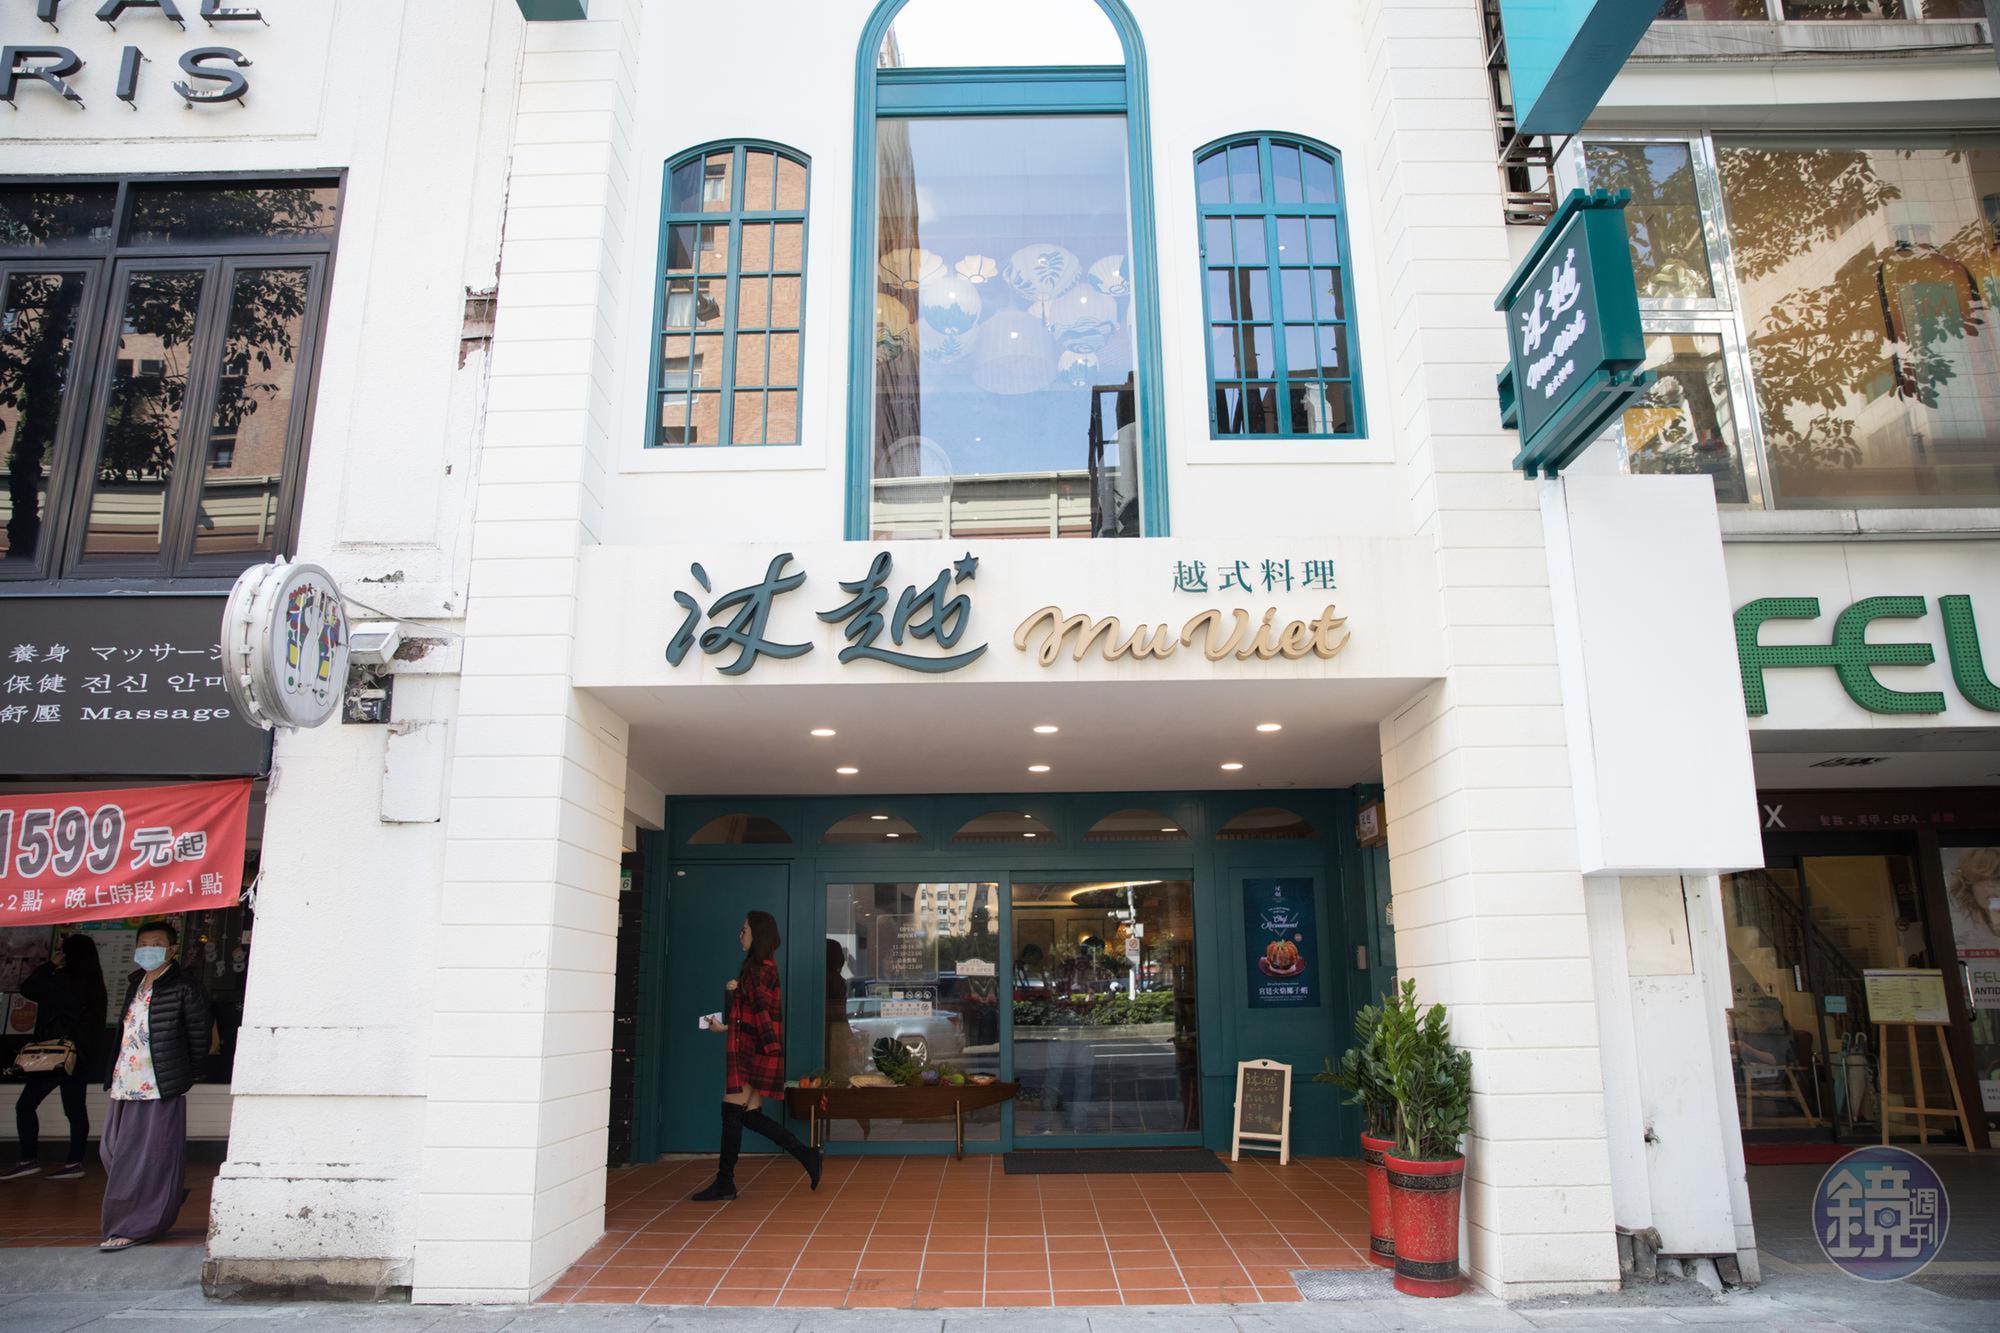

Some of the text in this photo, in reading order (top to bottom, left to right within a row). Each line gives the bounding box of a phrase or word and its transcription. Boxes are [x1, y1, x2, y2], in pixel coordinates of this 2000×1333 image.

[1173, 559, 1337, 593] 越式料理
[8, 643, 70, 663] 養身
[3, 674, 68, 694] 保健
[81, 673, 148, 694] 전신
[0, 704, 62, 723] 舒壓
[80, 707, 230, 722] Massage
